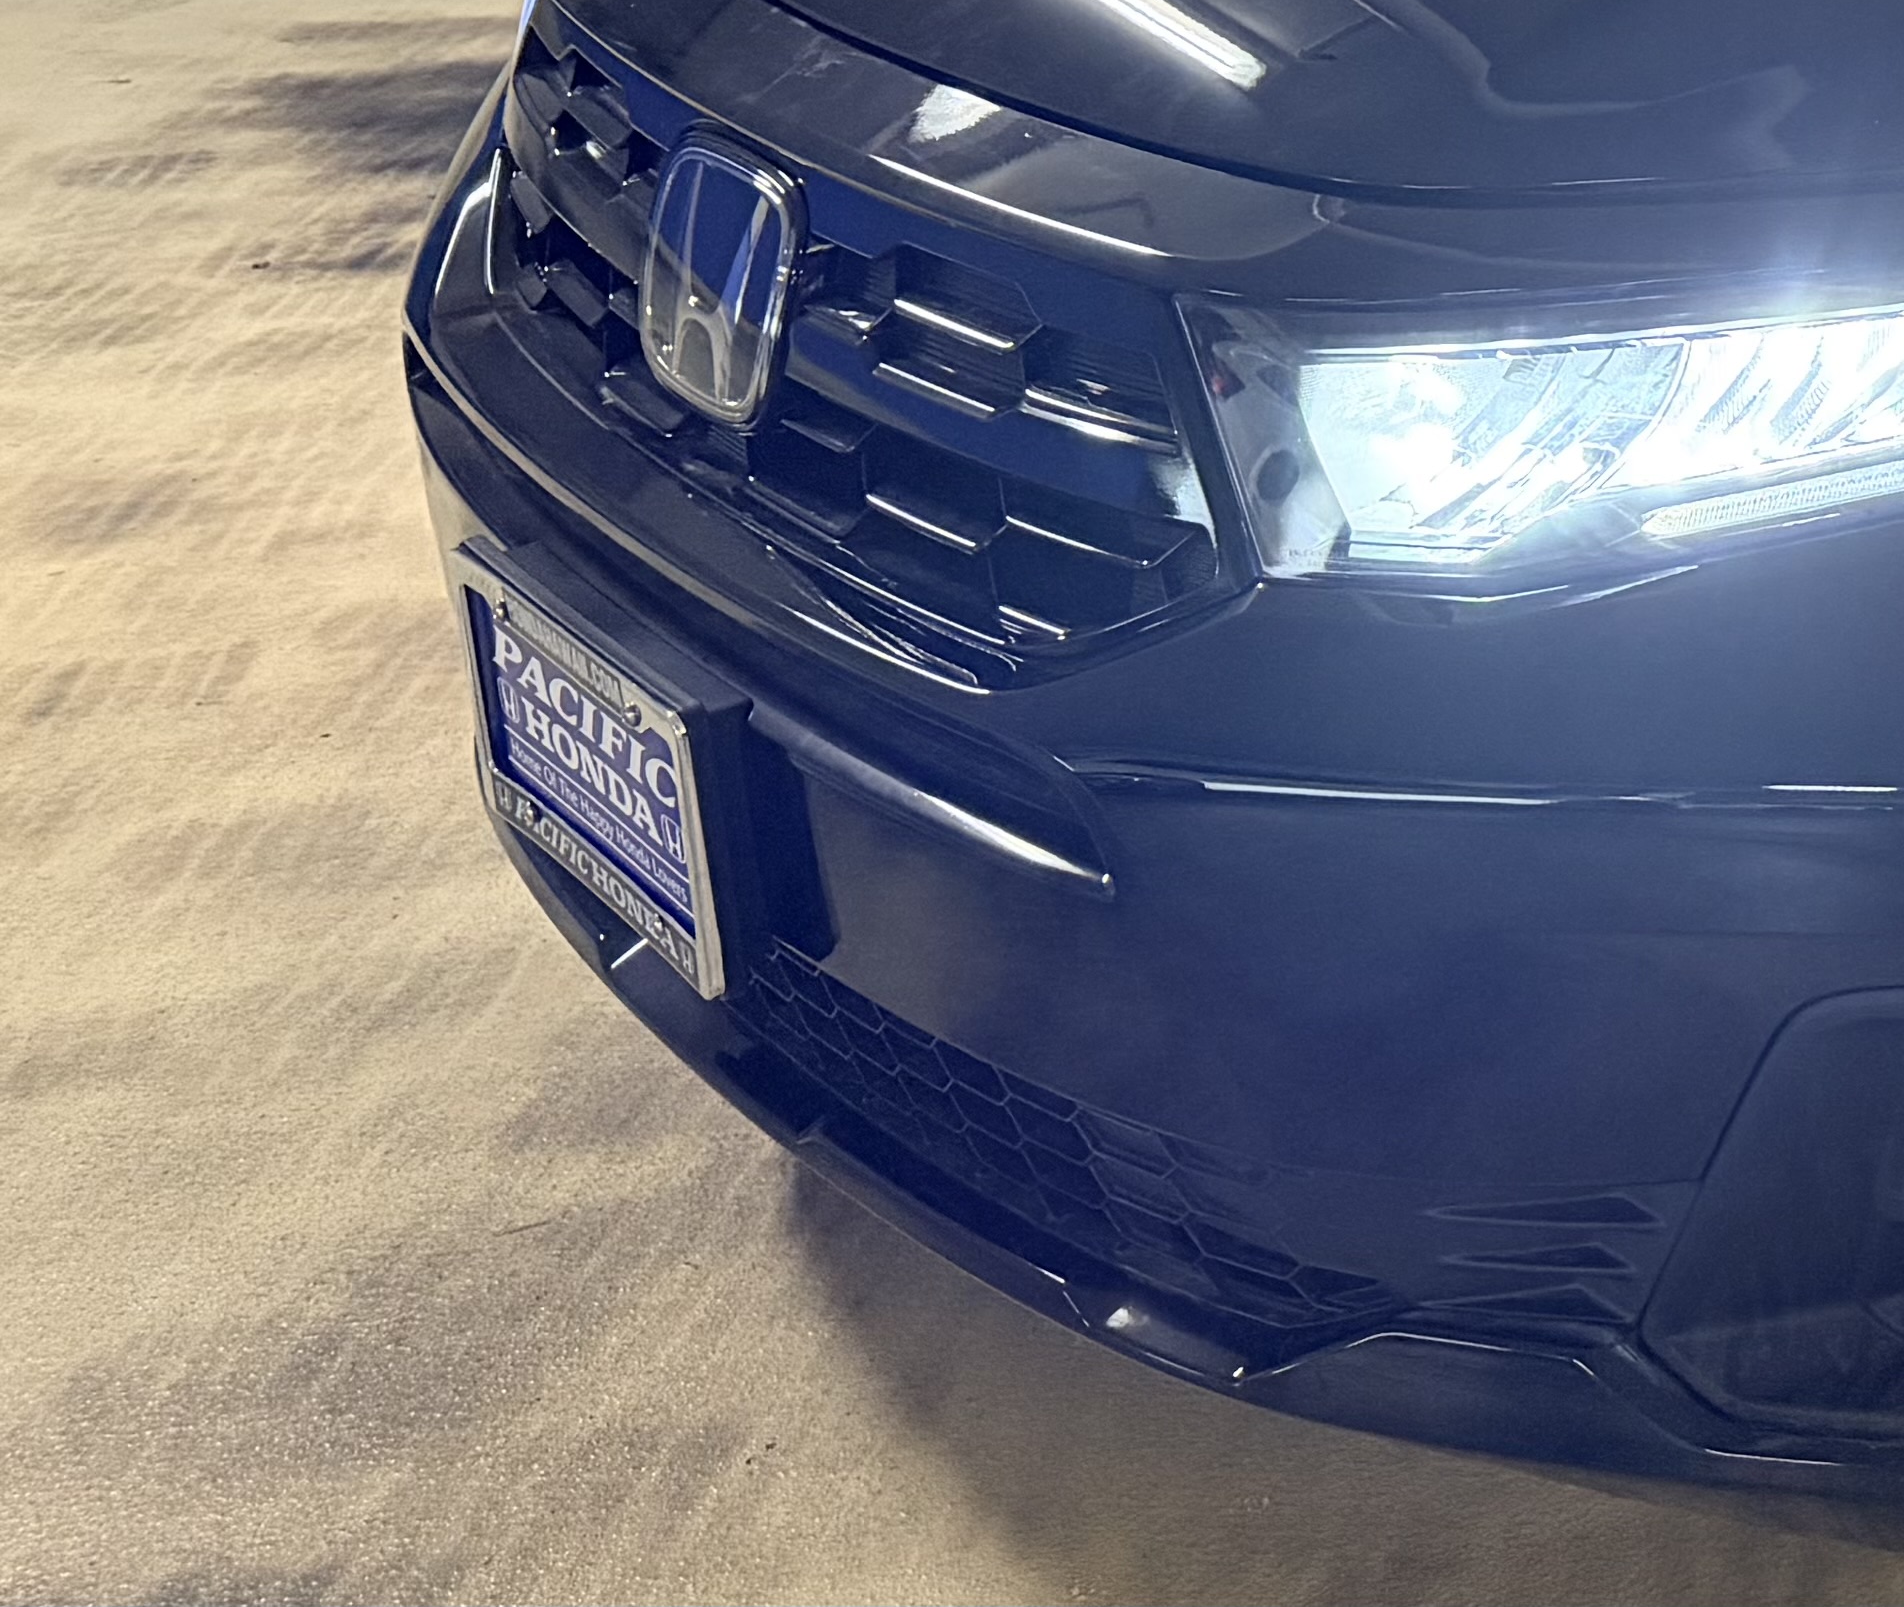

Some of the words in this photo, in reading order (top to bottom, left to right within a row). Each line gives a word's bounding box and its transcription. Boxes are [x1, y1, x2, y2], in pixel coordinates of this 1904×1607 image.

[492, 624, 677, 808] PACIFIC
[521, 696, 664, 846] HONDA
[510, 738, 543, 778] Home
[560, 778, 578, 808] The
[580, 799, 614, 841] Happy
[615, 825, 650, 871] Honda
[651, 859, 689, 903] Lovers
[515, 798, 590, 875] PCIFIC
